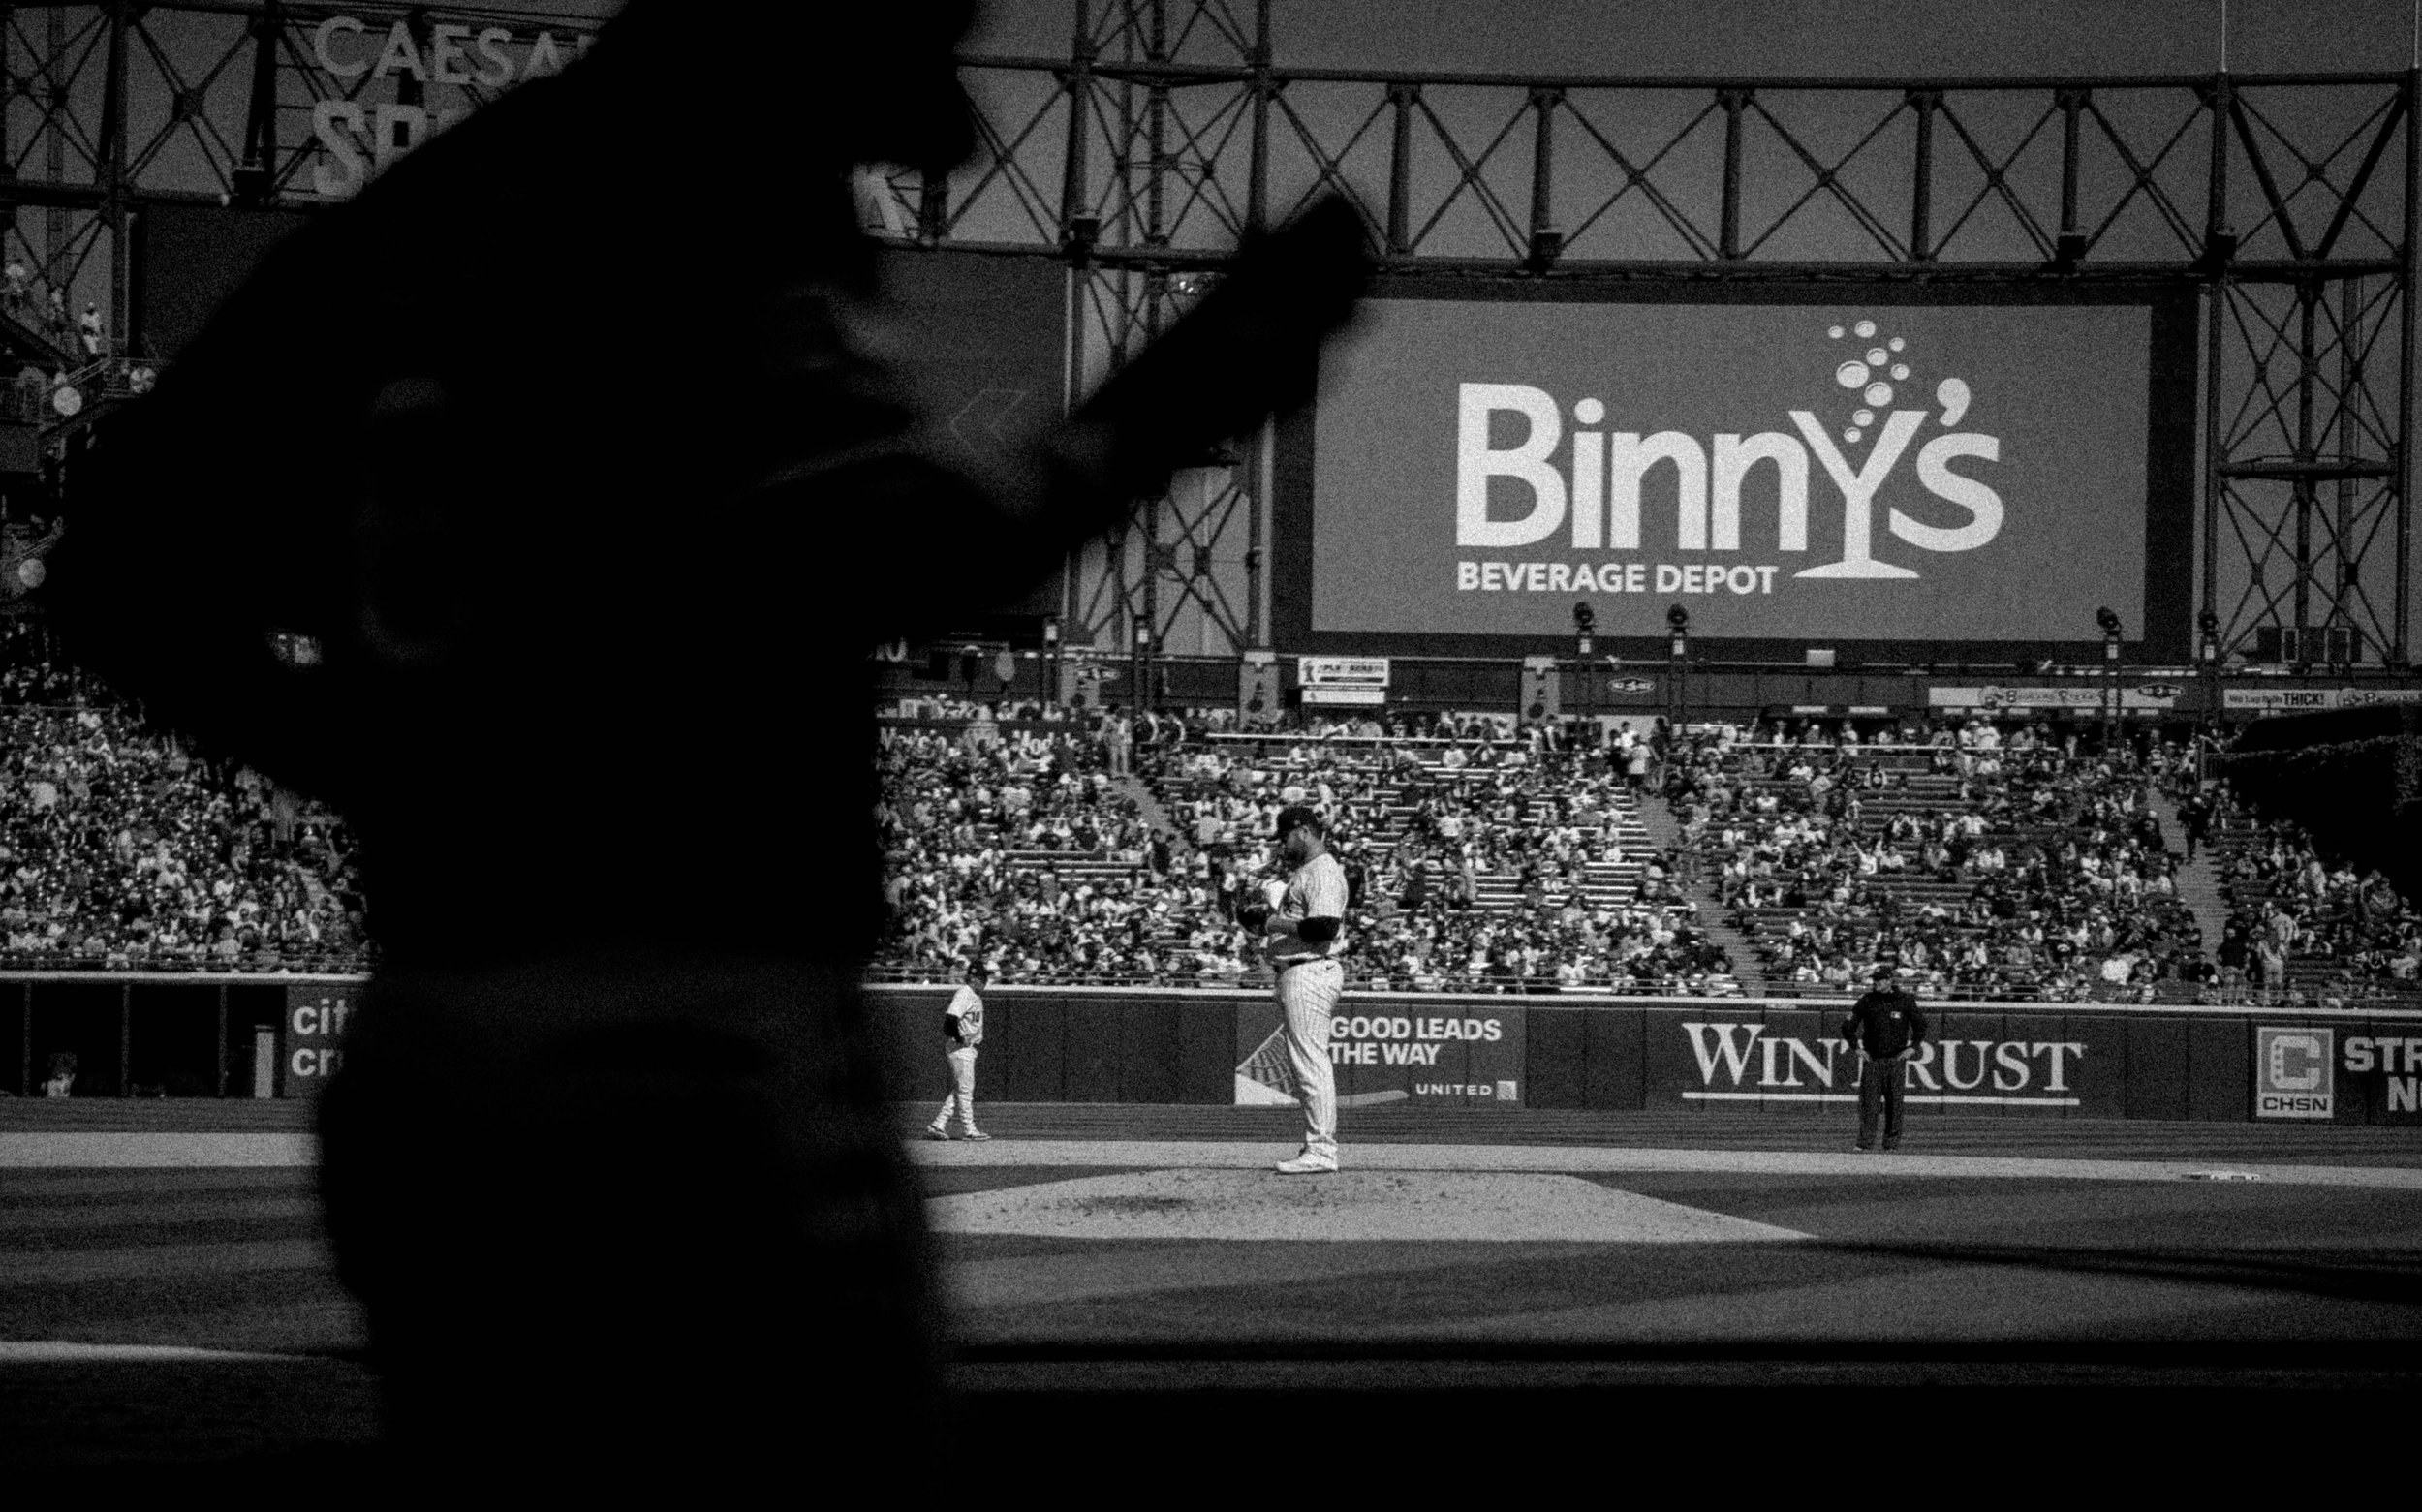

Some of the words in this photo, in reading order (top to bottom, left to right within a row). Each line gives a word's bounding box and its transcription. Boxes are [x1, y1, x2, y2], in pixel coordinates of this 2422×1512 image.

[314, 15, 600, 88] CAESA
[1457, 560, 1646, 594] BEVERAGE
[1655, 564, 1779, 595] DEPOT
[2283, 692, 2324, 706] THICK!
[1330, 1015, 1412, 1039] GOOD
[1416, 1017, 1503, 1041] LEADS
[1328, 1042, 1378, 1065] THE
[1382, 1042, 1442, 1065] WAY
[1415, 1083, 1493, 1095] UNITED
[2387, 1075, 2422, 1112] N
[2262, 1096, 2328, 1112] CHSN
